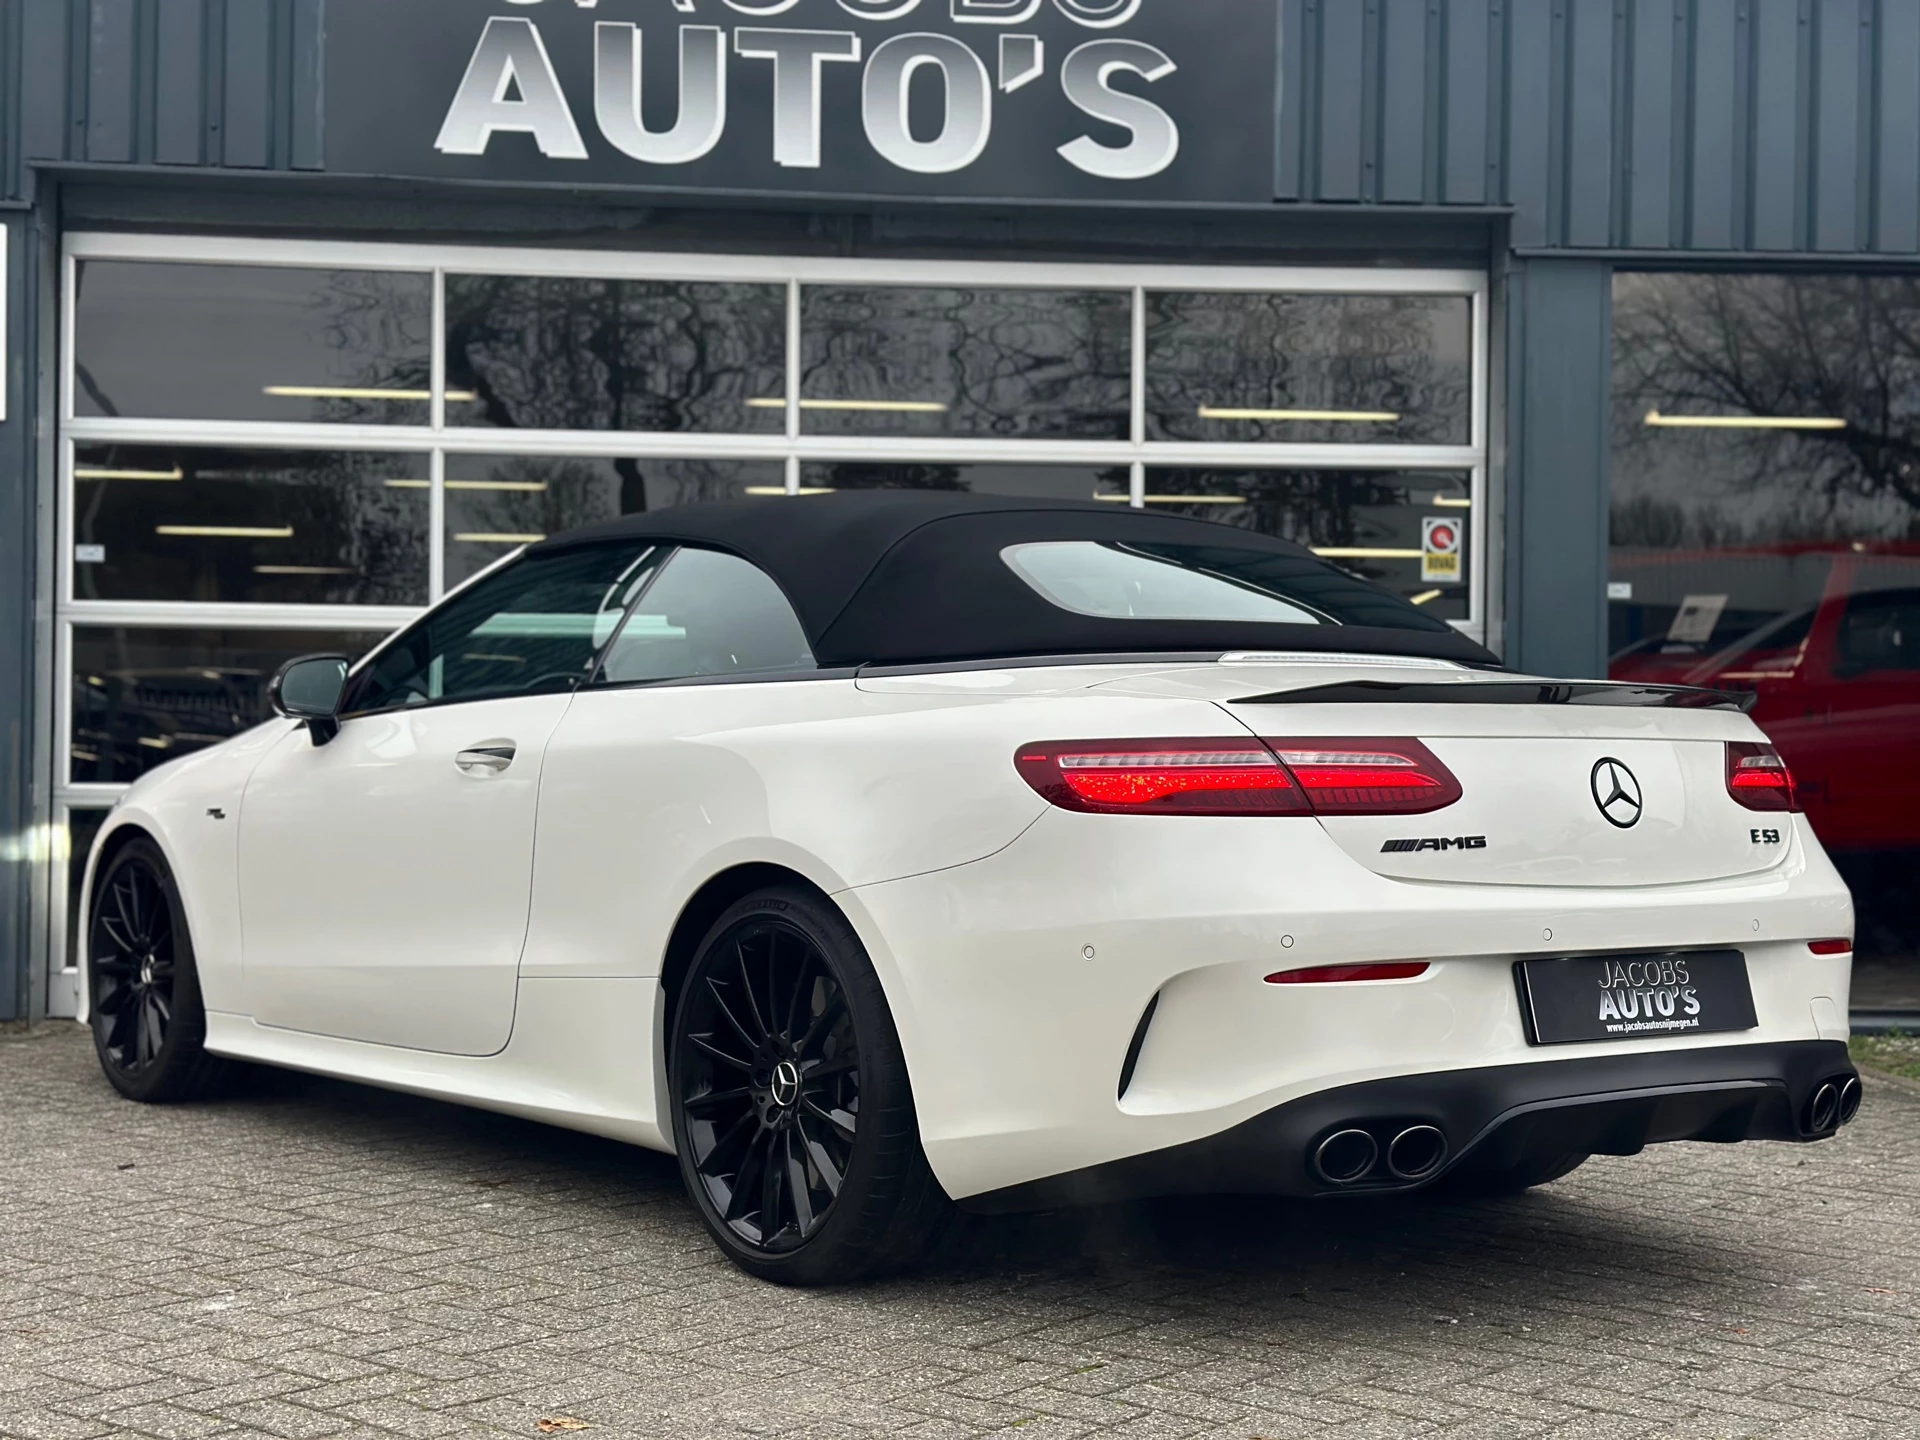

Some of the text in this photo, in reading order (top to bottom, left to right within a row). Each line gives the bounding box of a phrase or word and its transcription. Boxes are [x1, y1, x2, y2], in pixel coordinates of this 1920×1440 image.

[433, 16, 1180, 179] AUTO'S
[1415, 835, 1487, 851] AMG
[1598, 959, 1690, 988] JACOBS
[1599, 986, 1700, 1020] AUTO'S
[1606, 1017, 1700, 1033] www.jacobsautosnijmegen.nl
